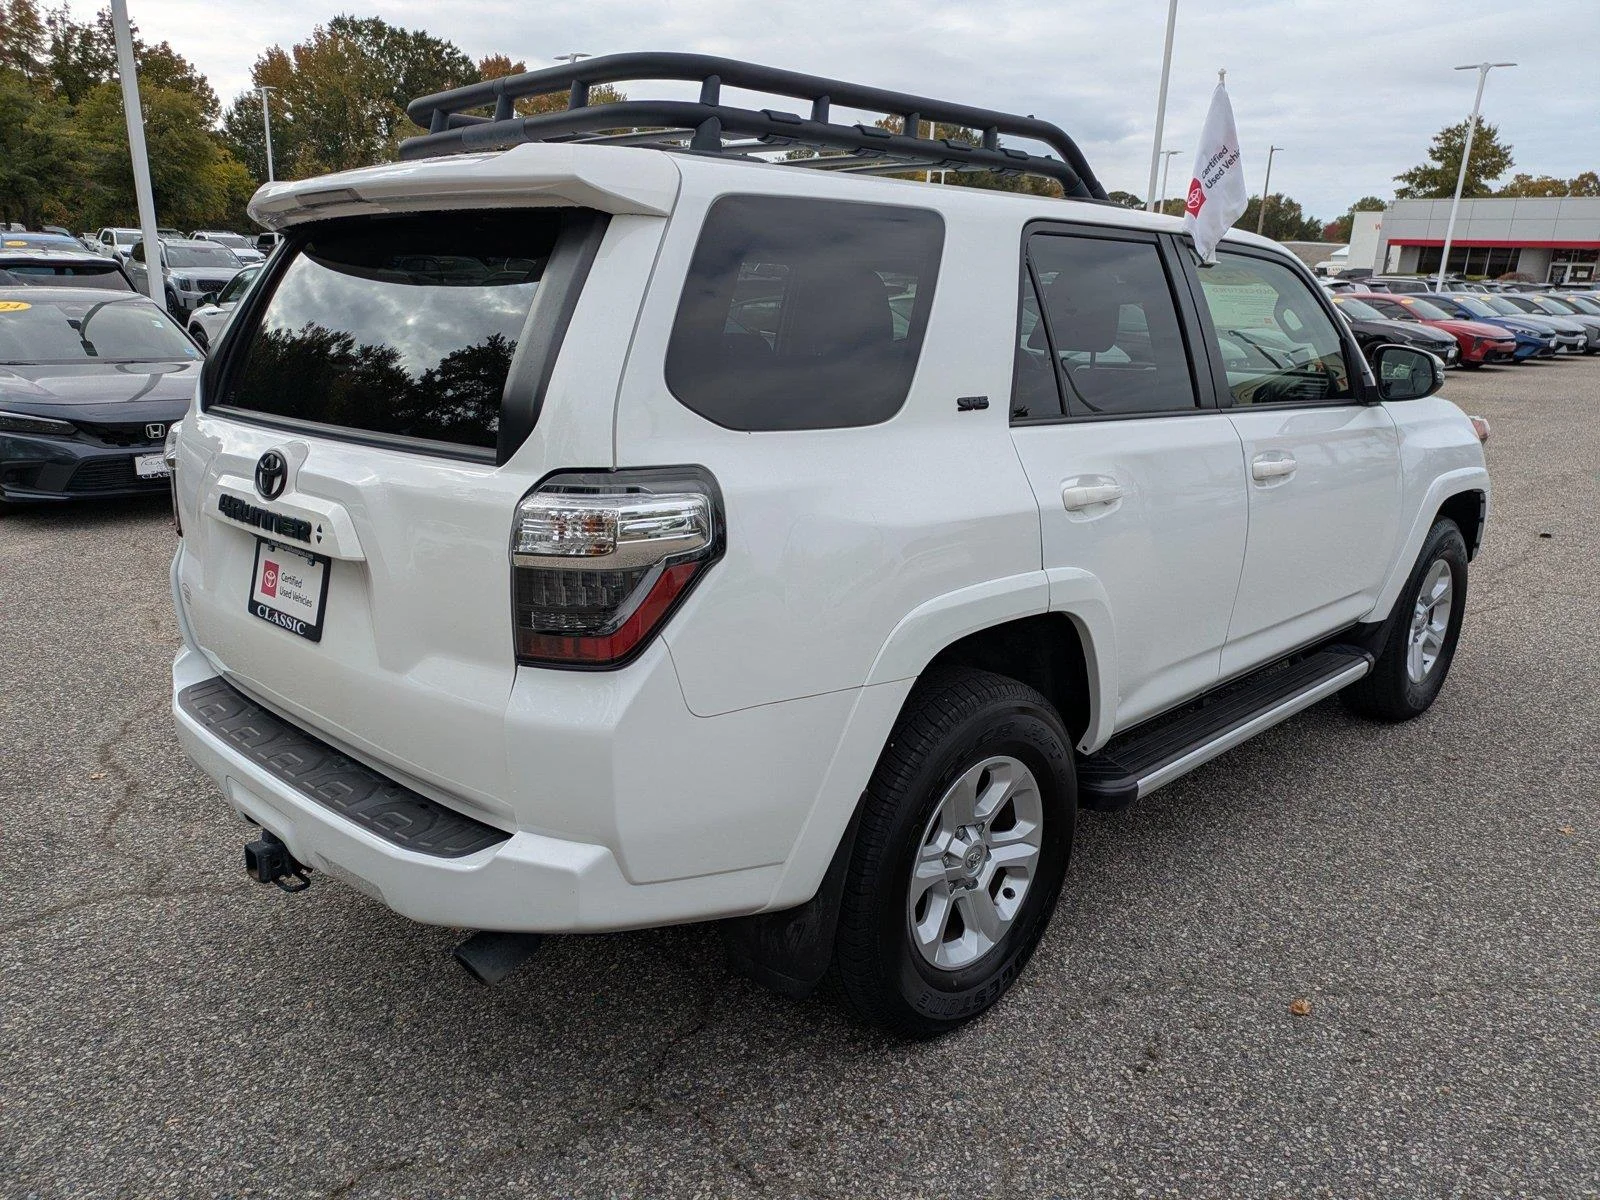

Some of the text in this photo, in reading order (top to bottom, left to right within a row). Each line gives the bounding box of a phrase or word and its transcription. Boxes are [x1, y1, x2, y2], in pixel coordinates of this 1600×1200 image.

[1201, 145, 1229, 179] Certified
[1205, 167, 1225, 189] Used
[280, 572, 303, 589] Certified
[279, 587, 313, 608] Used Vehicles
[257, 604, 306, 635] CLASSIC
